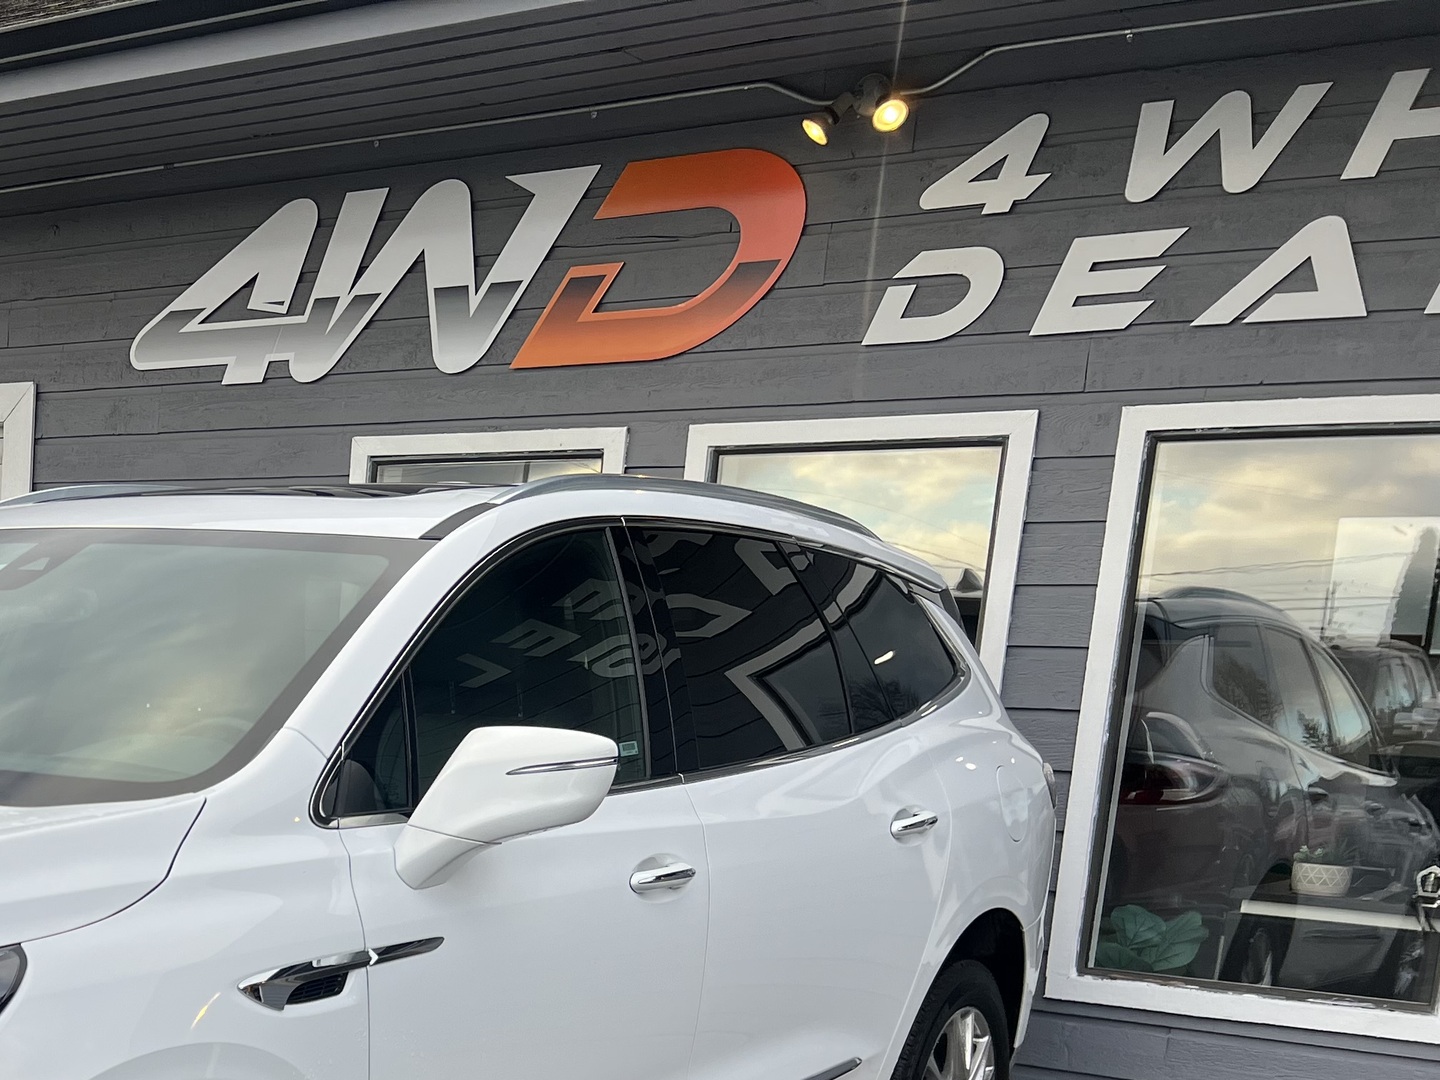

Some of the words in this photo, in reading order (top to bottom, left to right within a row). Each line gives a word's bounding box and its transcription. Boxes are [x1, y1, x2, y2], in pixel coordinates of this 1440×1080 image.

[919, 112, 1052, 215] 4
[130, 148, 808, 385] 4WD
[860, 214, 1440, 346] DEA
